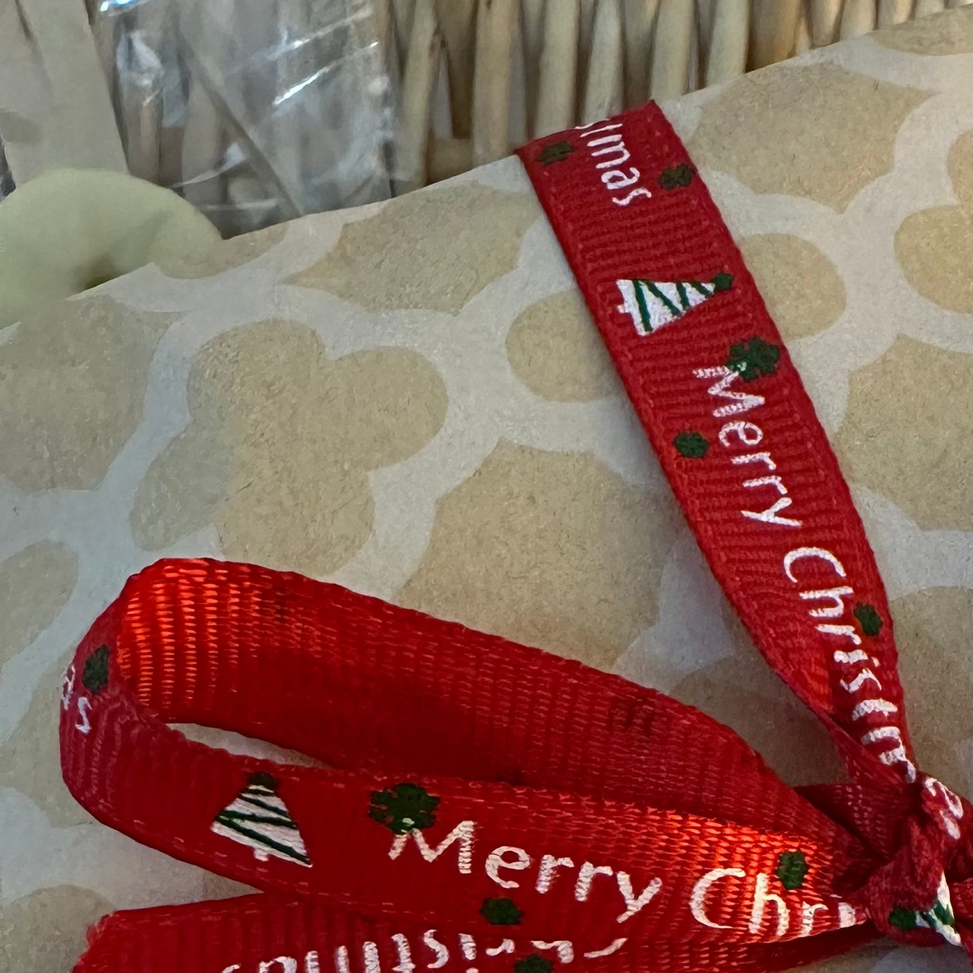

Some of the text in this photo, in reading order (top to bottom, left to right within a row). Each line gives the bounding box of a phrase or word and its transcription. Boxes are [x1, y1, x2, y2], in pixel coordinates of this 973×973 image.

[692, 361, 916, 784] Merry Christm
[388, 817, 663, 924] Merry
